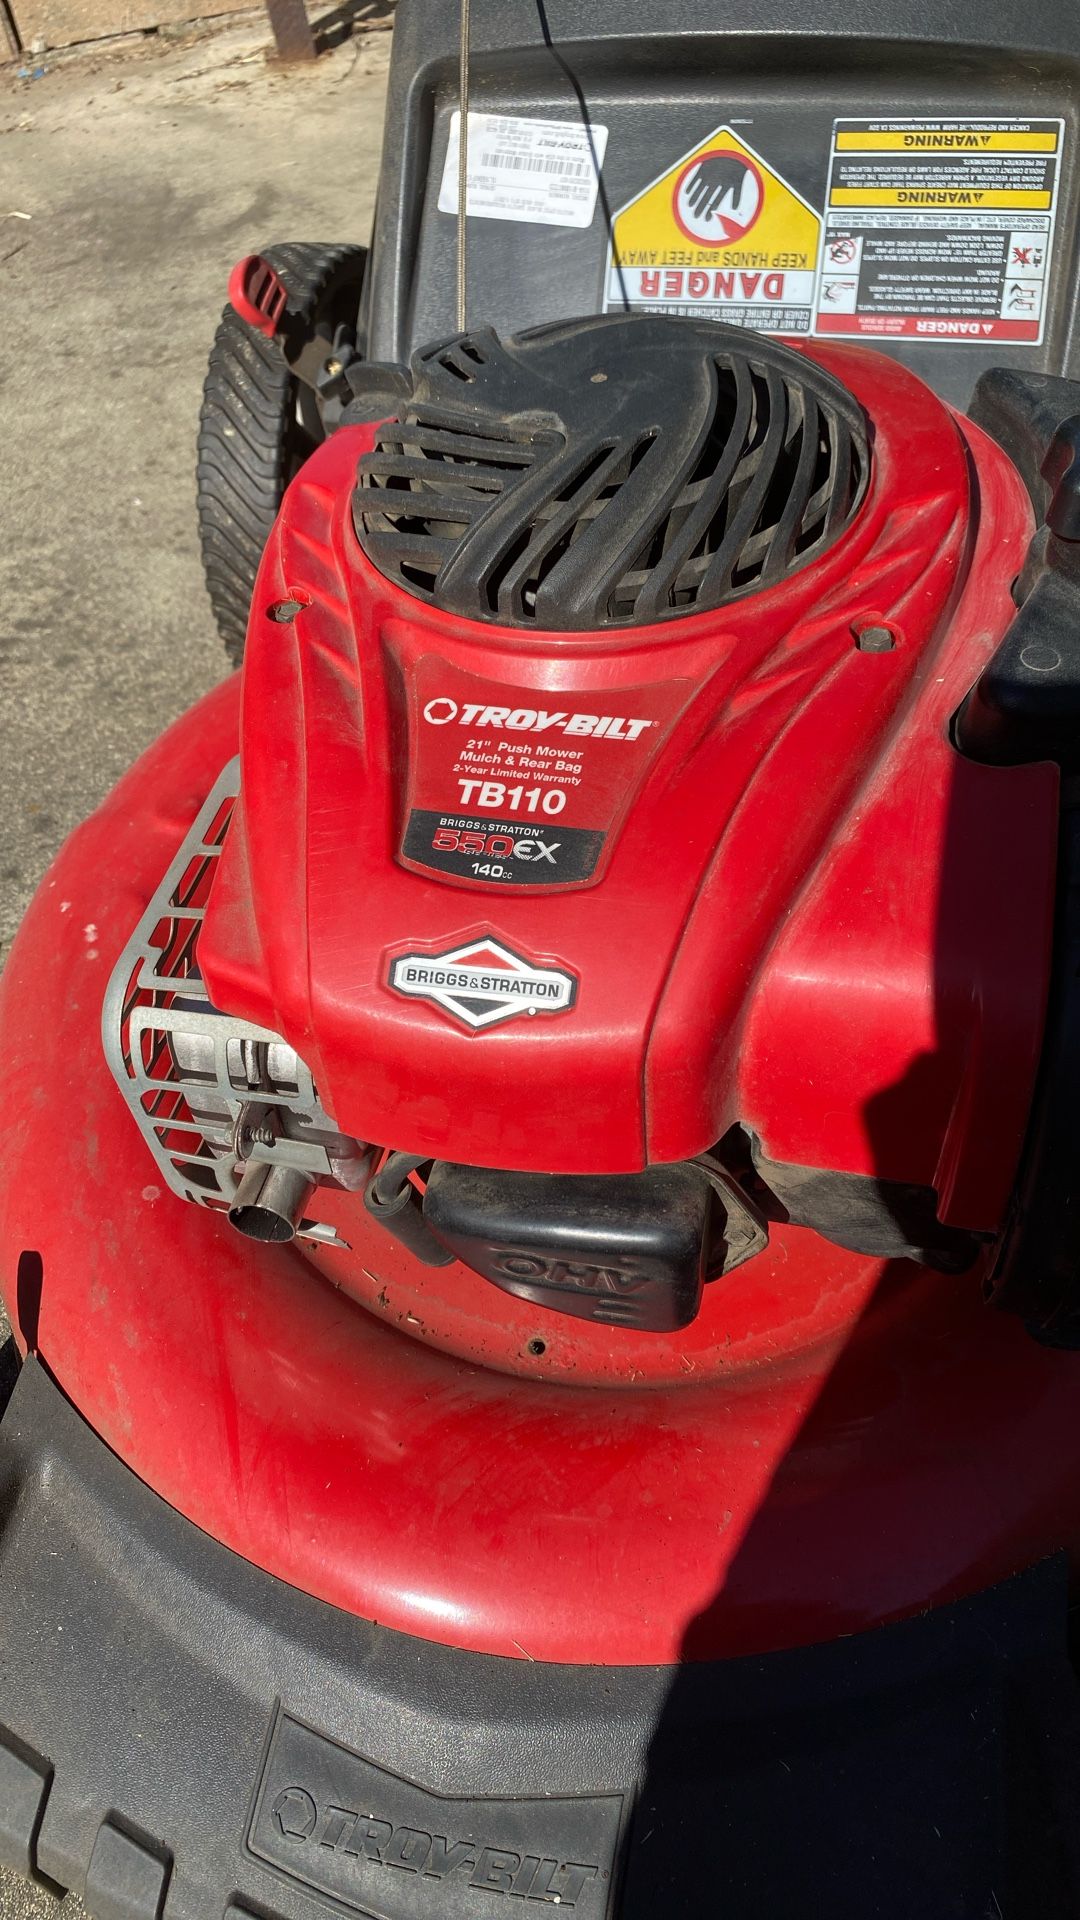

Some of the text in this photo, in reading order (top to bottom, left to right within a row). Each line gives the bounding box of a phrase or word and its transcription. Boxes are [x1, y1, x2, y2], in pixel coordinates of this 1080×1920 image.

[904, 135, 978, 146] WARNING
[897, 192, 971, 204] WARNING
[946, 233, 981, 241] BACKWARDS.
[616, 251, 808, 268] KEEP HANDS and FEET AWAY
[640, 271, 785, 300] DANGER
[668, 306, 676, 315] IN
[678, 307, 686, 316] IS
[688, 307, 720, 317] CATCHER
[722, 308, 744, 317] GRASS
[746, 309, 771, 318] ENTIRE
[772, 309, 783, 318] OR
[784, 310, 810, 319] COVER
[743, 318, 809, 329] DO NOT OPERATE
[916, 321, 980, 334] DANGER
[458, 704, 654, 740] TROY-BILT
[466, 740, 584, 760] 21" Push Mower
[459, 751, 582, 774] Mulch & Rear Bag
[453, 764, 582, 786] 2-Year Limited Warranty
[457, 778, 567, 815] TB110
[317, 805, 599, 908] TROY-BILT
[498, 1254, 651, 1294] OHV
